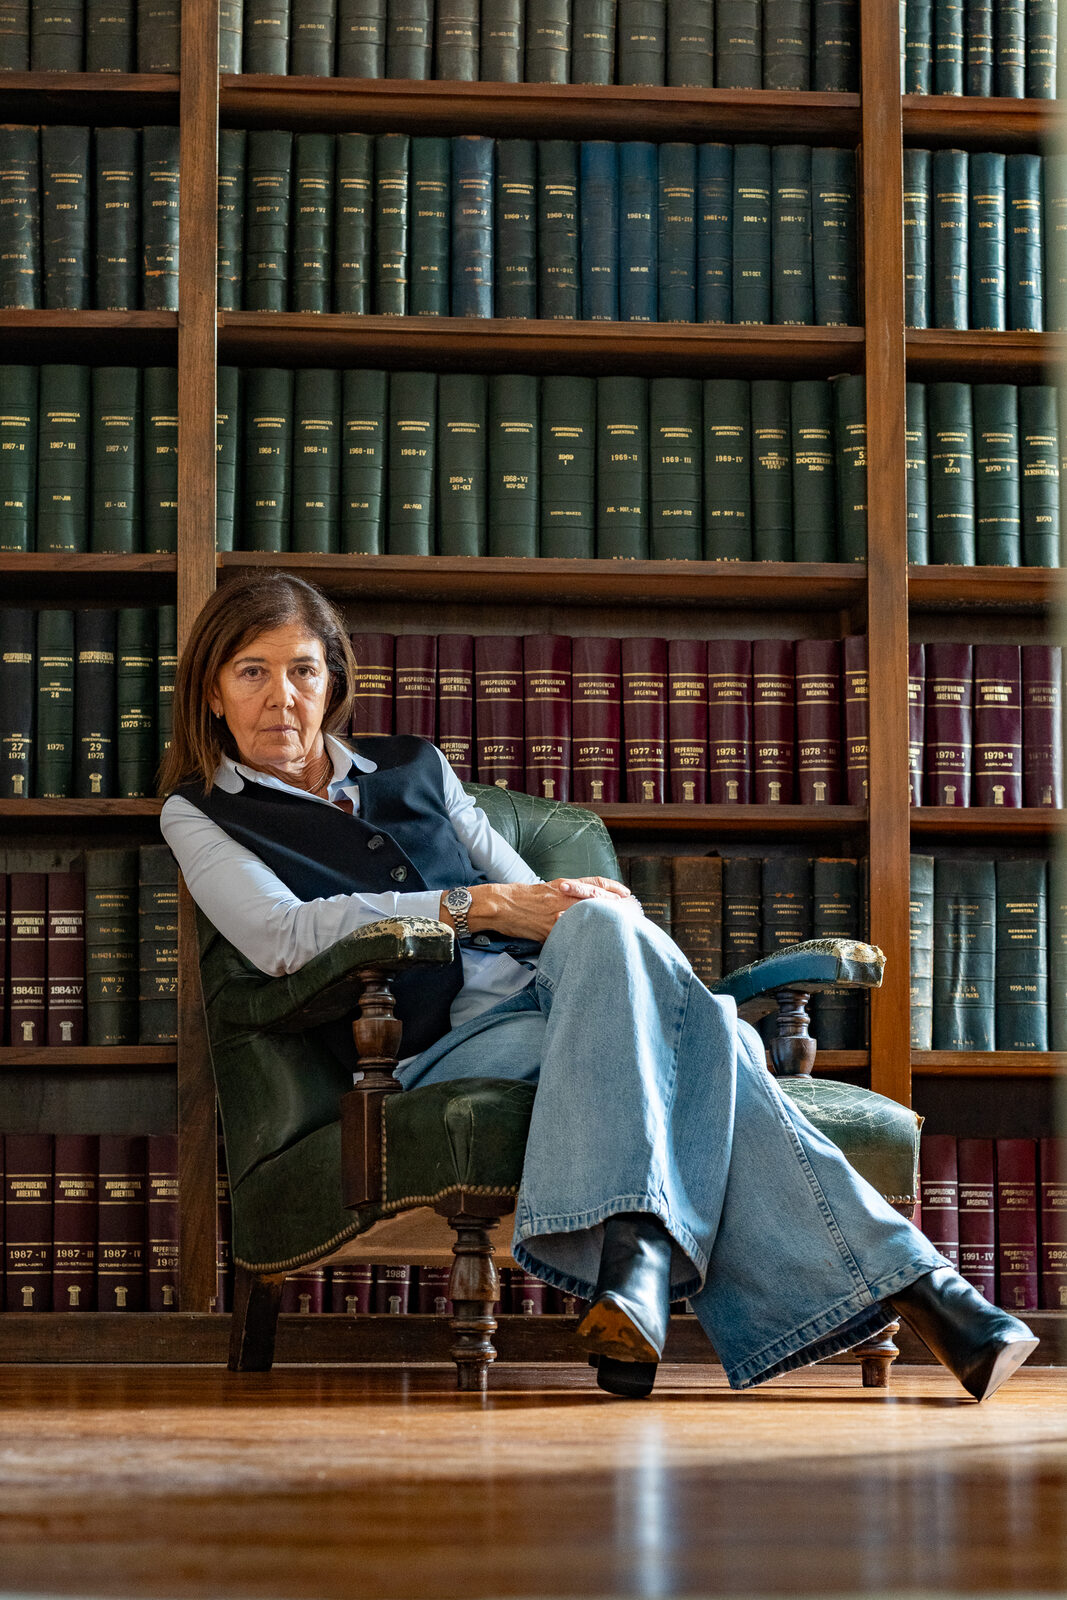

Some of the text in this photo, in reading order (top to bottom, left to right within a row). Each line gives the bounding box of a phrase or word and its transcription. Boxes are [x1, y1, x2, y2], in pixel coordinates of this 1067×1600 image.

[12, 743, 23, 751] 27
[90, 743, 102, 751] 29
[680, 757, 700, 765] 1977
[17, 926, 39, 934] ARGENTINA
[55, 926, 77, 934] ARGENTINA
[51, 986, 82, 994] 1984-IV
[386, 1270, 406, 1278] 1988
